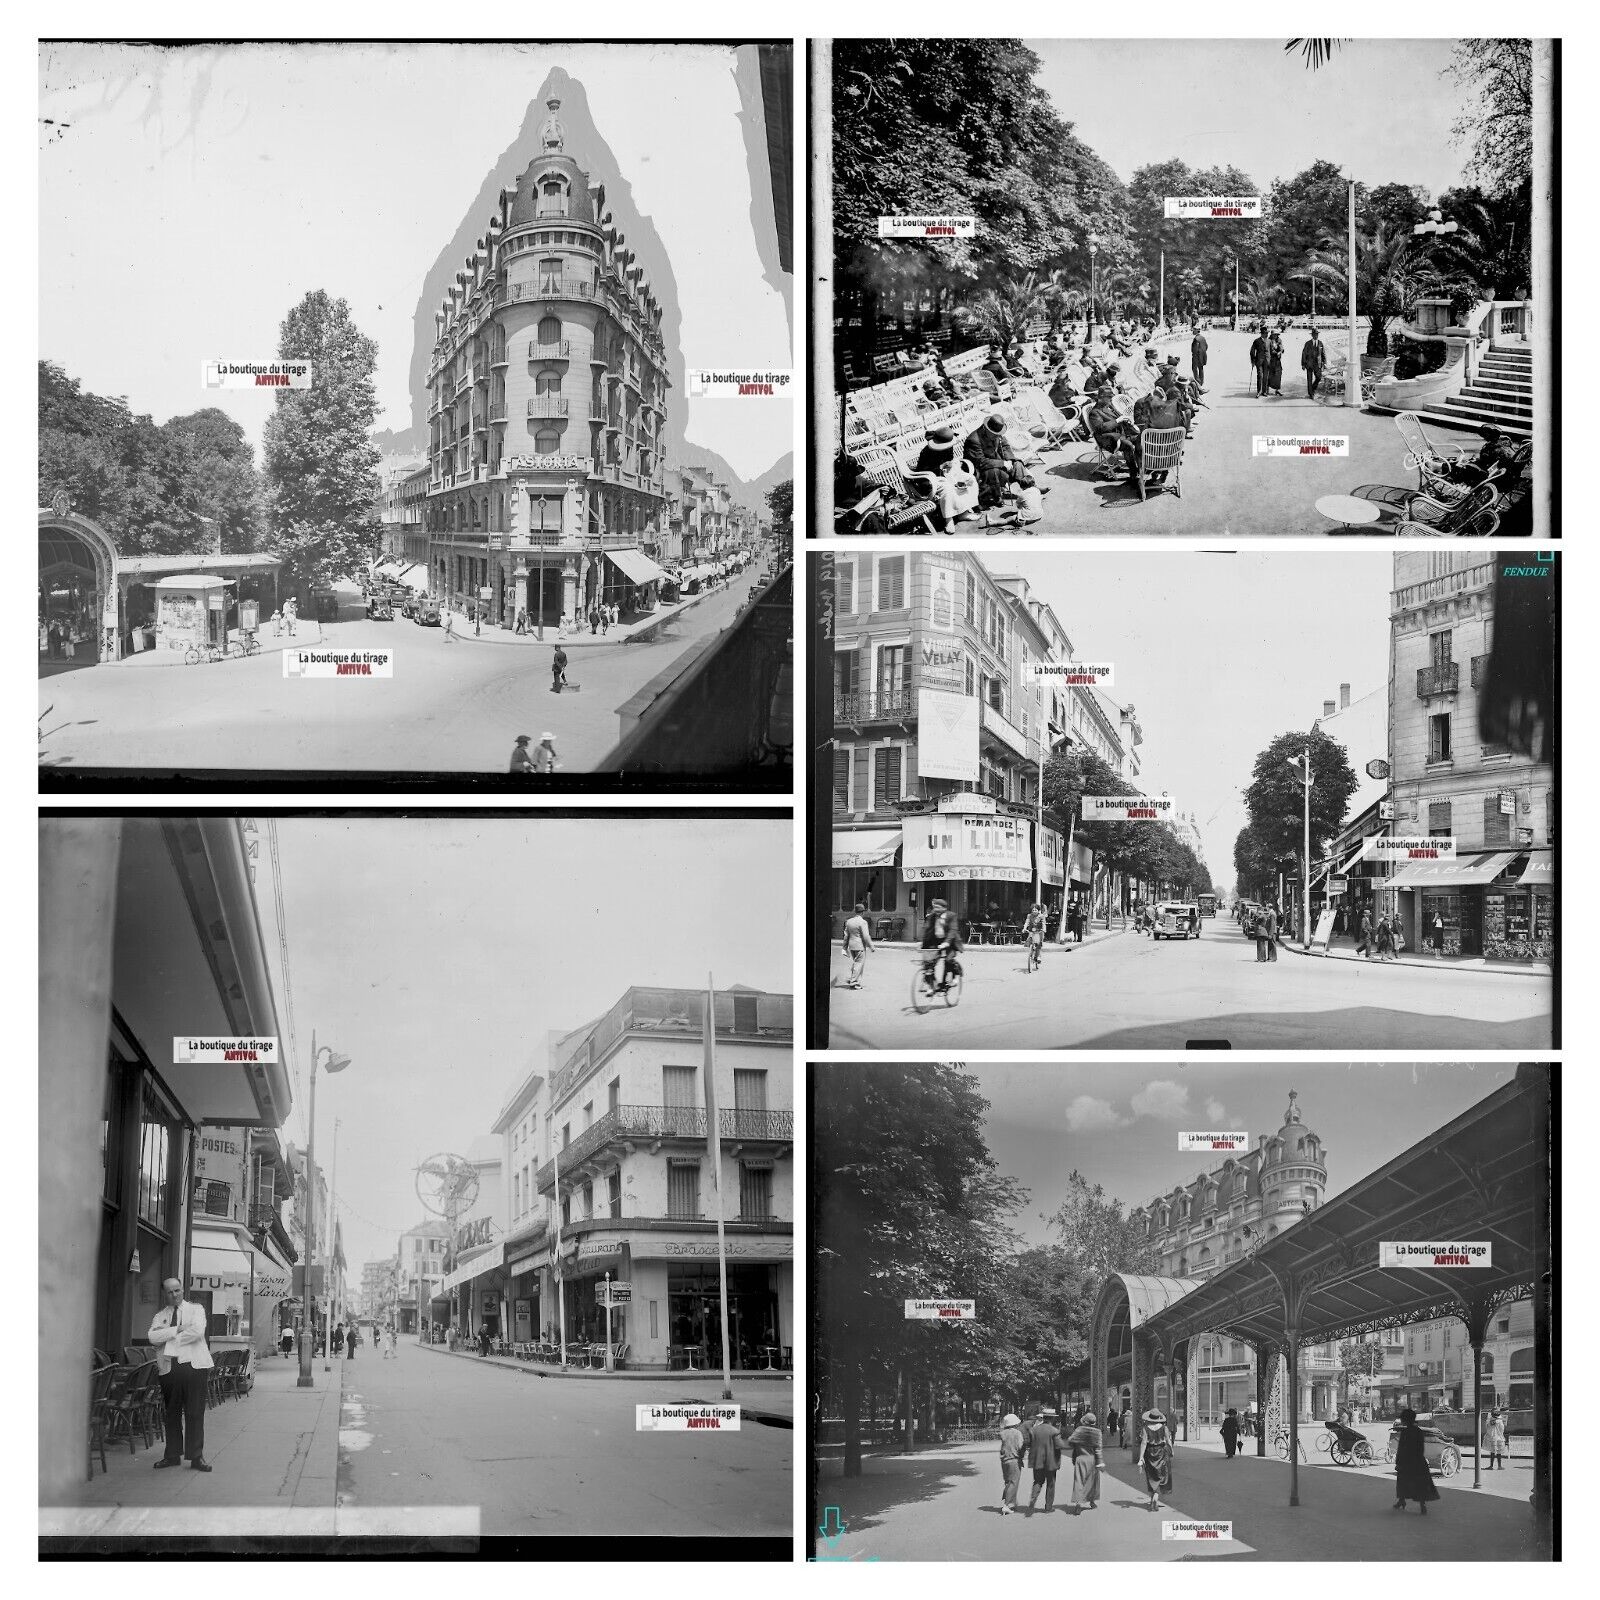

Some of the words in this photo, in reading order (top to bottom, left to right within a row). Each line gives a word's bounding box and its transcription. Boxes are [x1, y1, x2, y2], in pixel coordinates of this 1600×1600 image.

[517, 455, 578, 469] ASTORIA
[922, 649, 961, 666] VELAY
[928, 834, 953, 850] UN
[970, 830, 1024, 853] LILET
[1413, 865, 1496, 875] TABAC
[202, 1138, 236, 1154] POSTES
